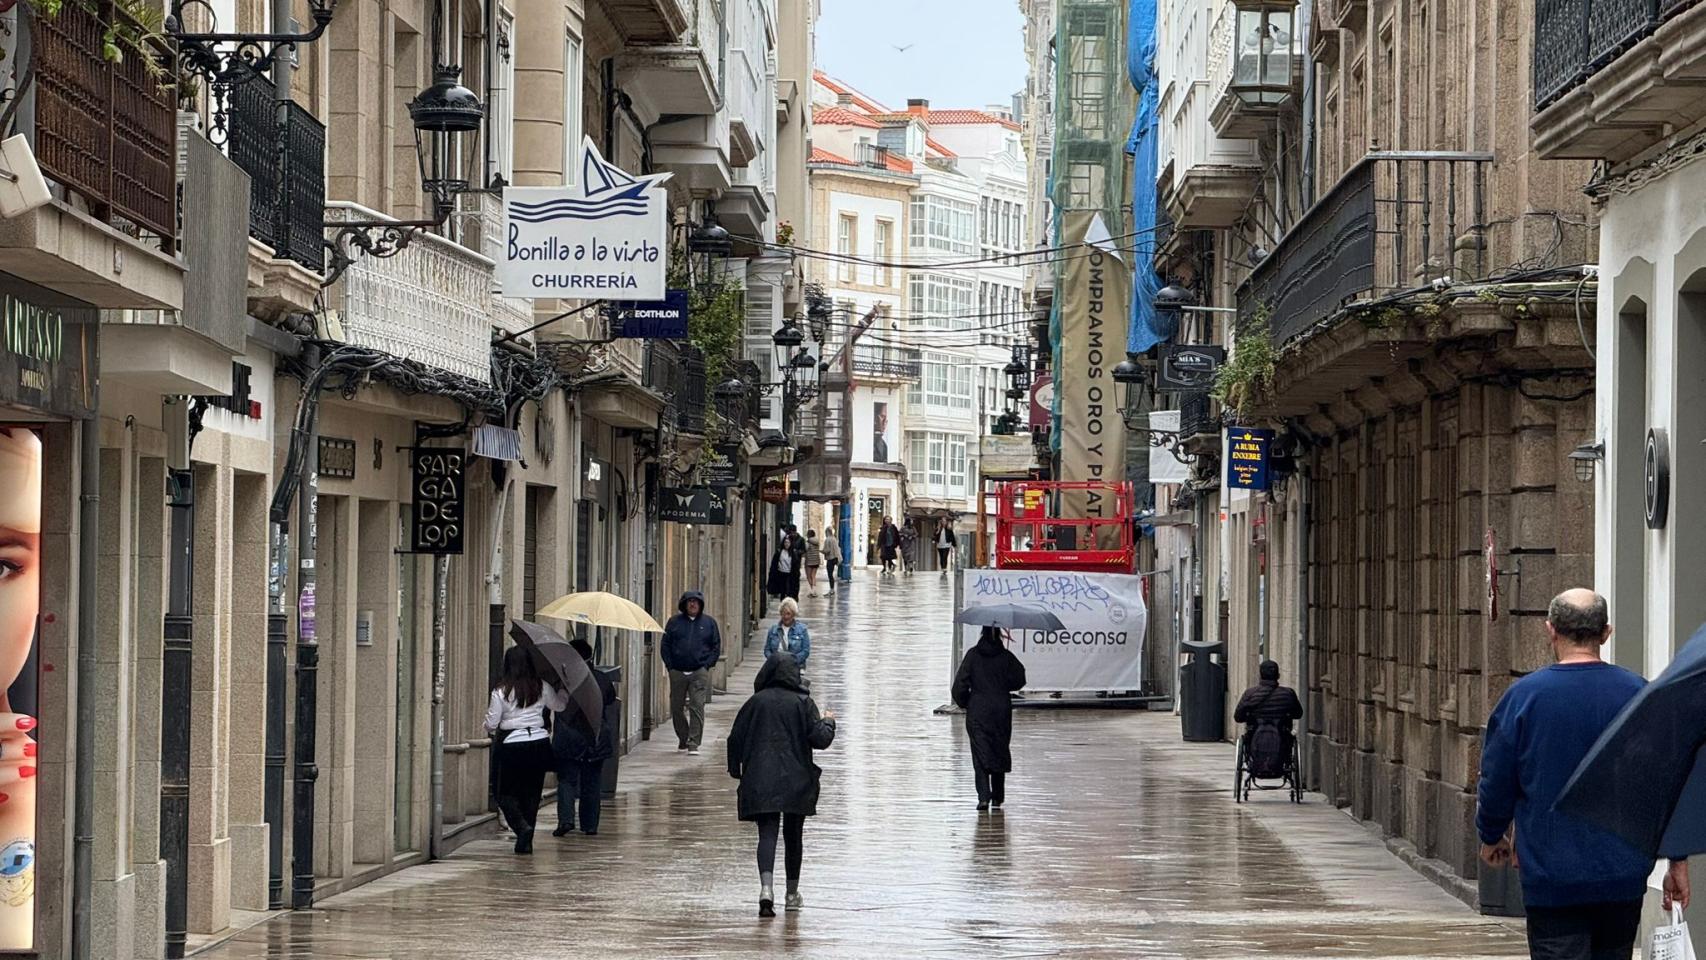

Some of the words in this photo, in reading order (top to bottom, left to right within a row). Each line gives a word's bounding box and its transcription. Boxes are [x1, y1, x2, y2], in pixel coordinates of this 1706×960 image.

[508, 222, 570, 261] Bonilla
[574, 244, 585, 261] a
[592, 237, 608, 261] la
[613, 240, 659, 262] vista
[532, 271, 638, 289] CHURRERÍA
[1087, 249, 1104, 380] OMPRAMOS
[1087, 386, 1103, 436] ORO
[1087, 443, 1103, 457] Y
[418, 455, 461, 475] SAR
[419, 477, 457, 499] GA
[419, 501, 458, 522] DE
[660, 510, 707, 519] APODEMIA
[418, 524, 459, 548] LOS
[1032, 630, 1128, 645] abeconsa
